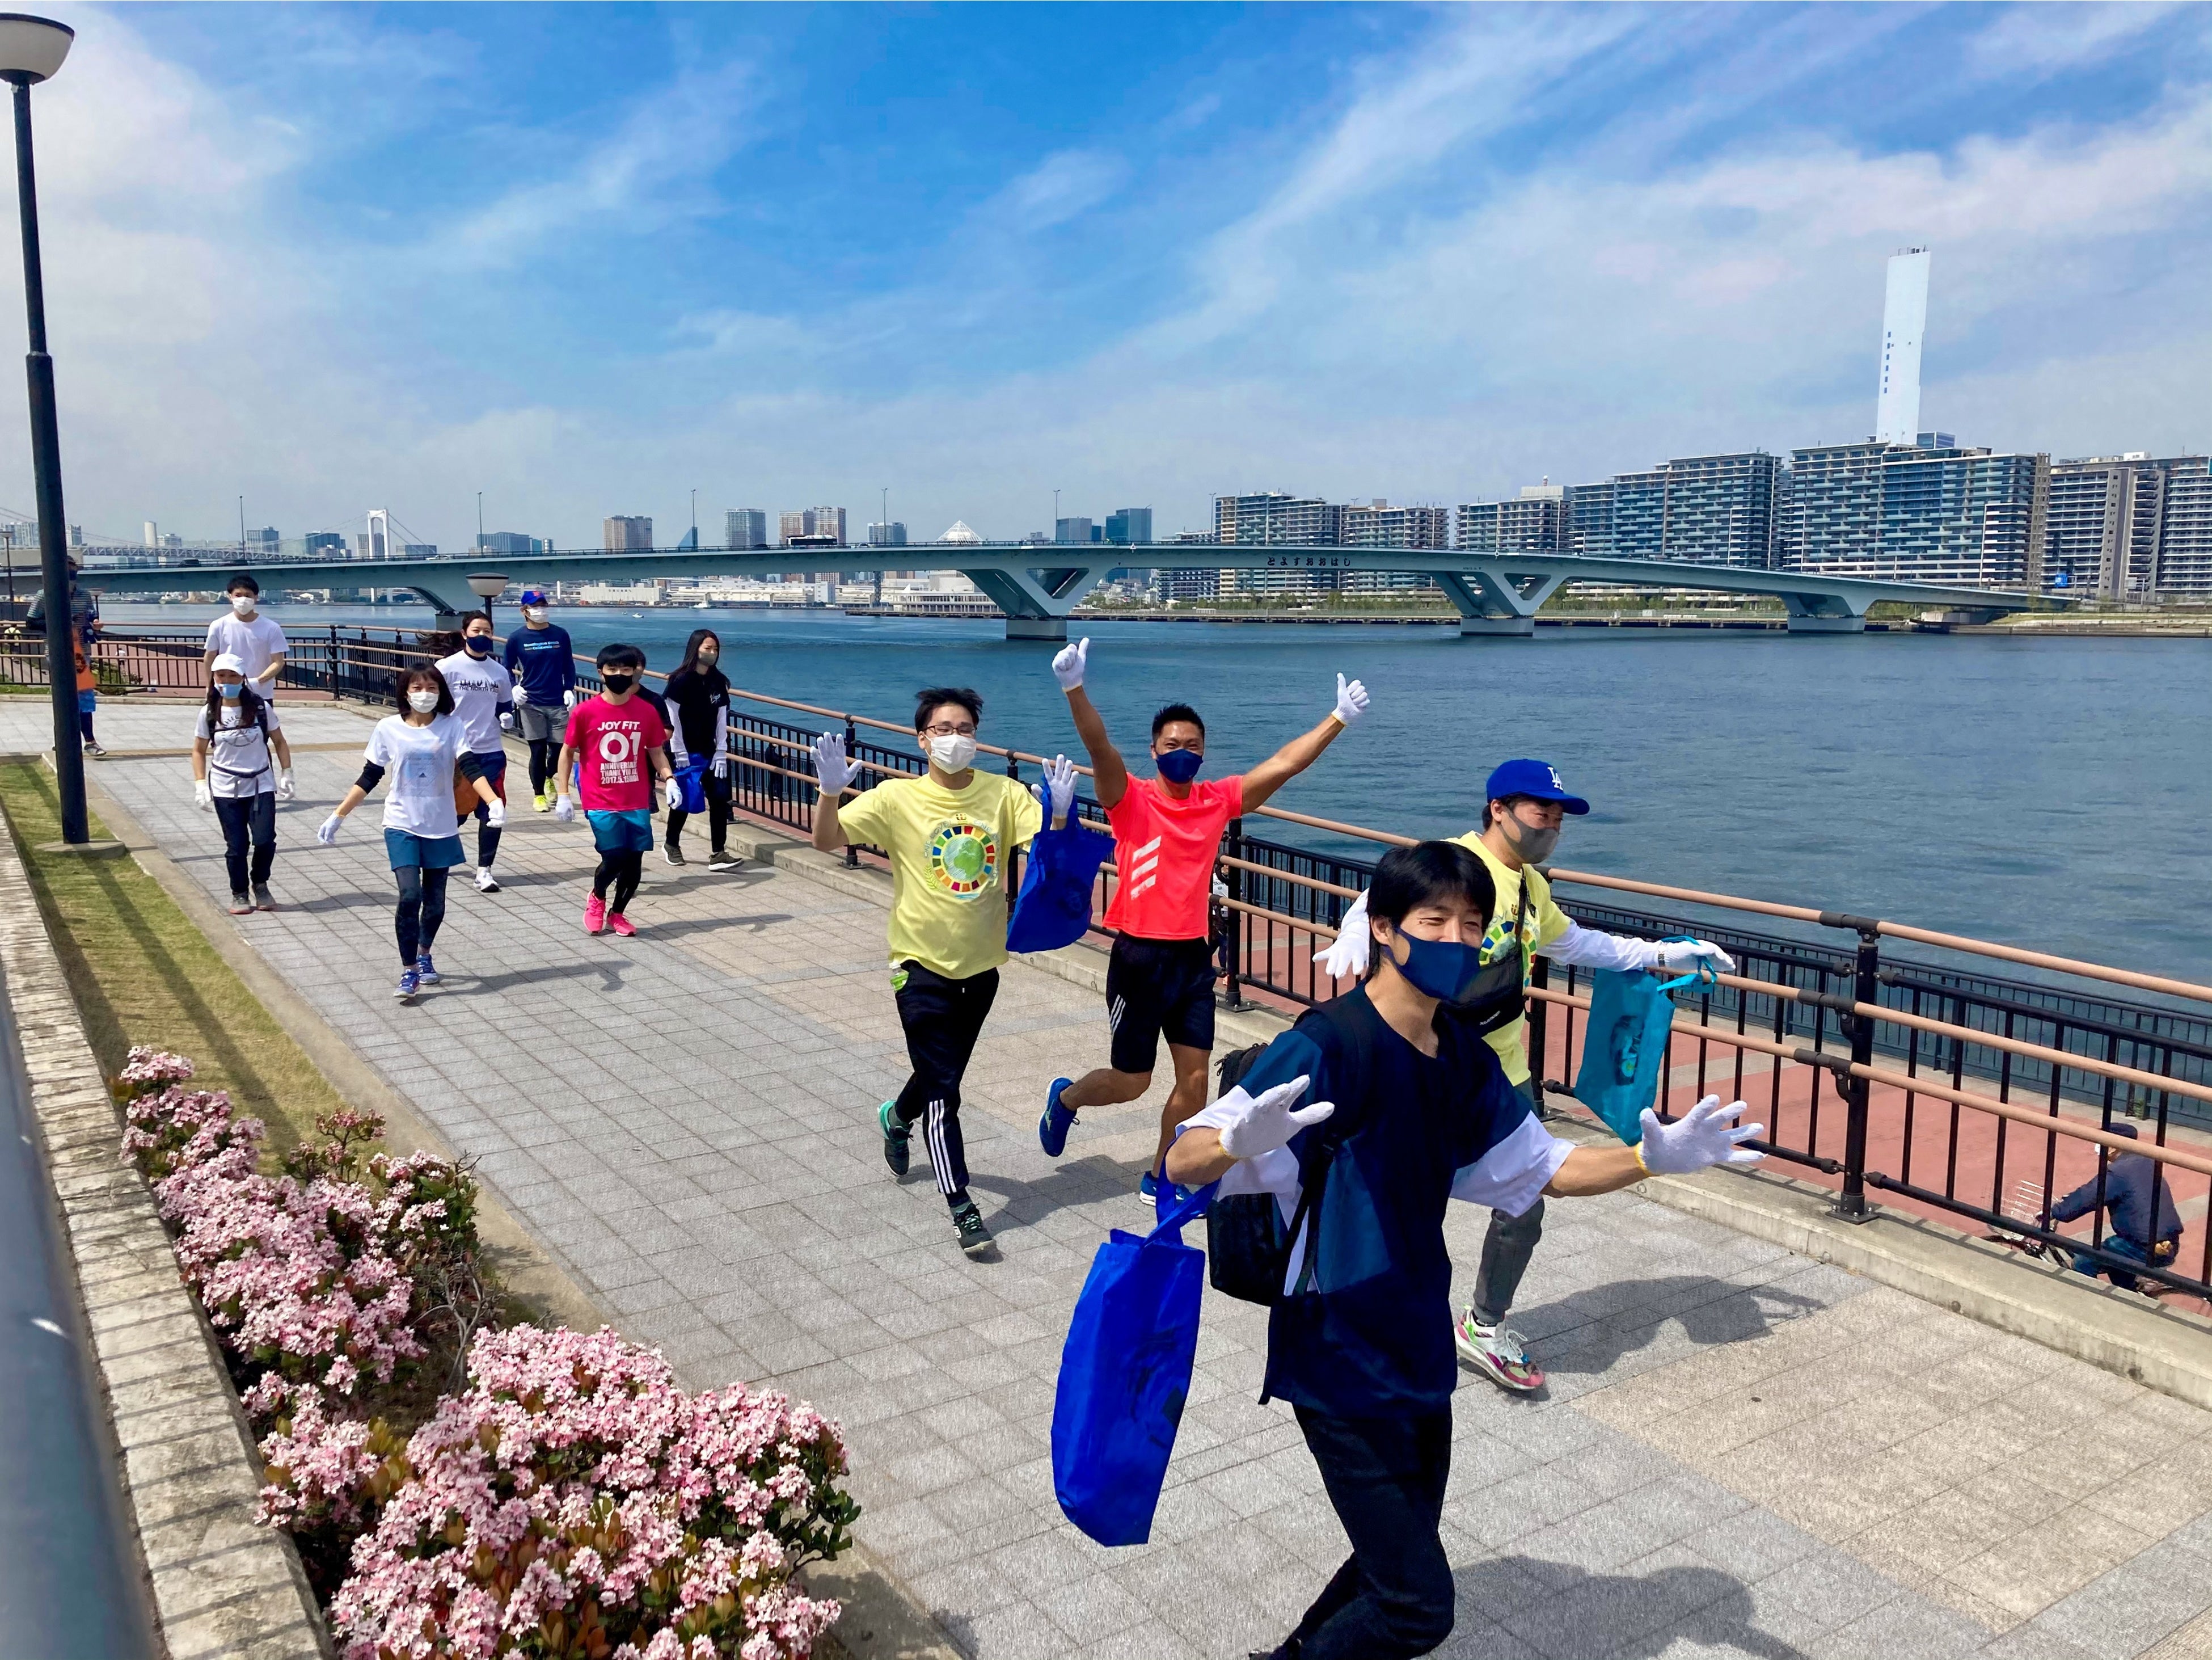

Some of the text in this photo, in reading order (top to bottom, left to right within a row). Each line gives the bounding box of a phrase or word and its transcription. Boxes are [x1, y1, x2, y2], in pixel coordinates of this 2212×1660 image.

[1267, 557, 1350, 567] とよすおおはし
[597, 721, 621, 731] JOY
[599, 731, 641, 762] 01
[1547, 767, 1564, 790] LA
